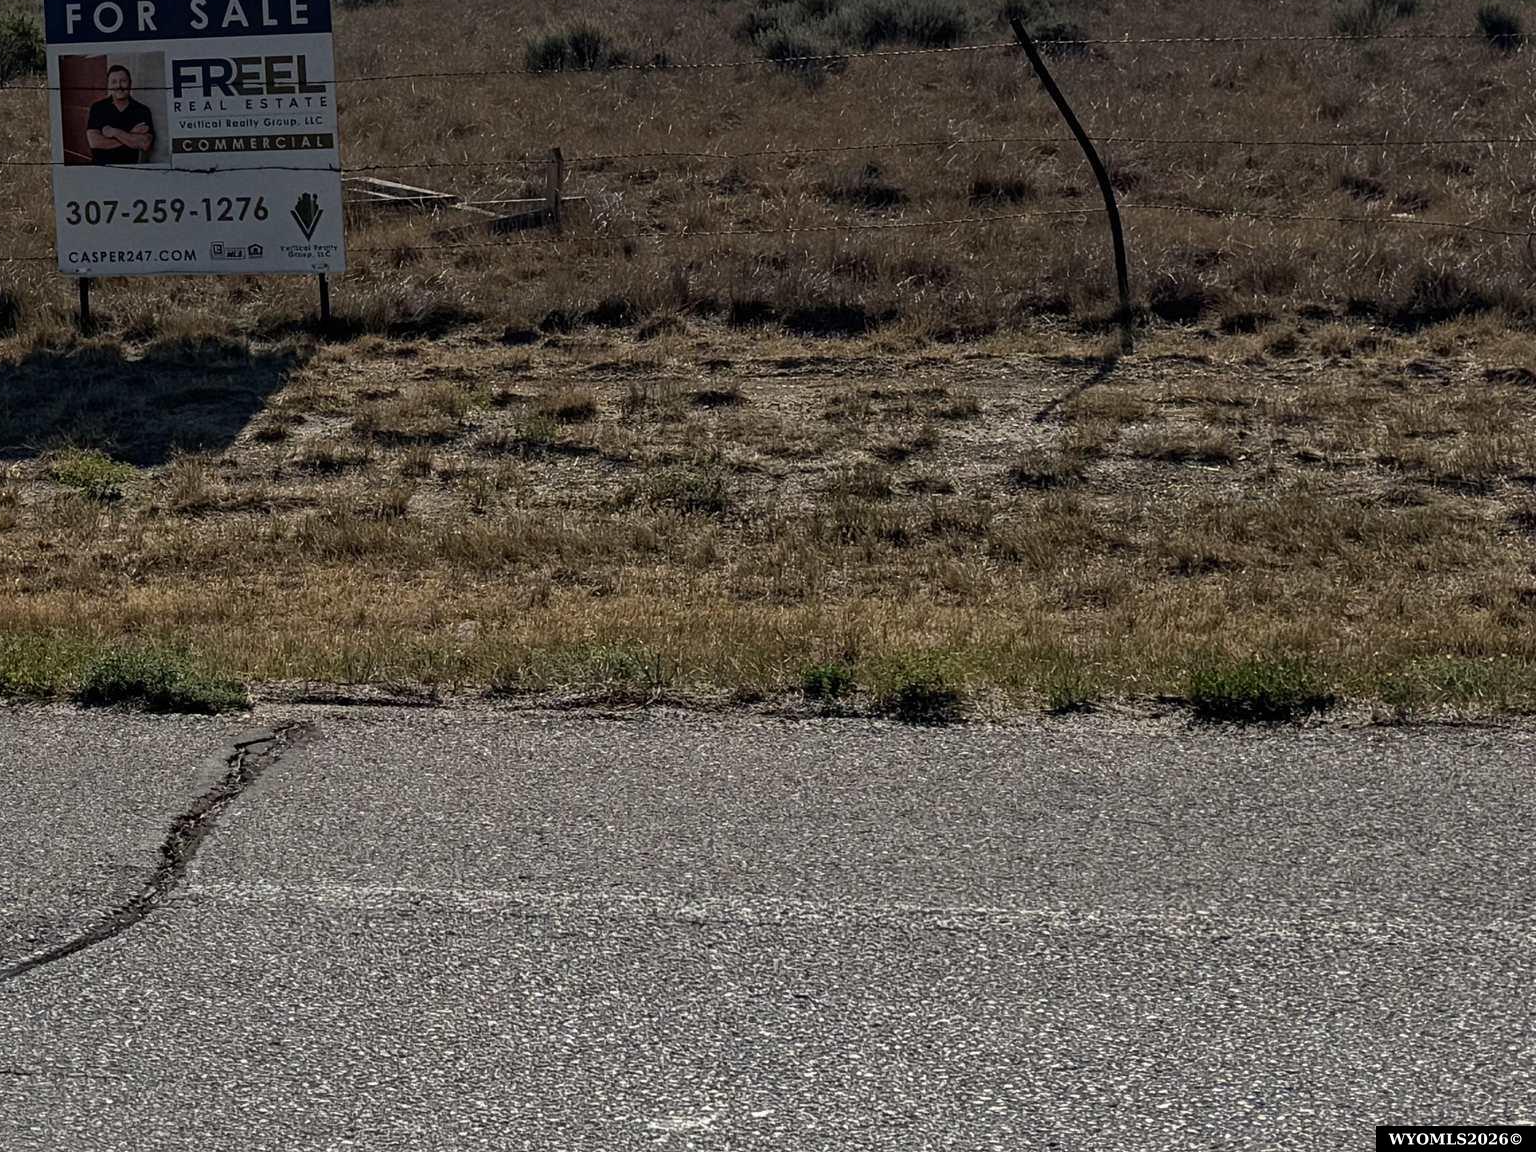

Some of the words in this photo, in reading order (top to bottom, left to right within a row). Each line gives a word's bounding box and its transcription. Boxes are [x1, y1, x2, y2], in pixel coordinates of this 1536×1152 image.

[65, 0, 157, 35] FOR
[172, 54, 327, 98] FREEL
[174, 100, 227, 113] REAL
[245, 96, 328, 109] ESTATE
[179, 119, 222, 129] Vertical
[226, 118, 259, 129] Realty
[305, 116, 323, 125] LLC
[182, 137, 324, 152] COMMERCIAL
[65, 196, 269, 226] 307-259-1276
[68, 249, 197, 264] CASPER247.COM
